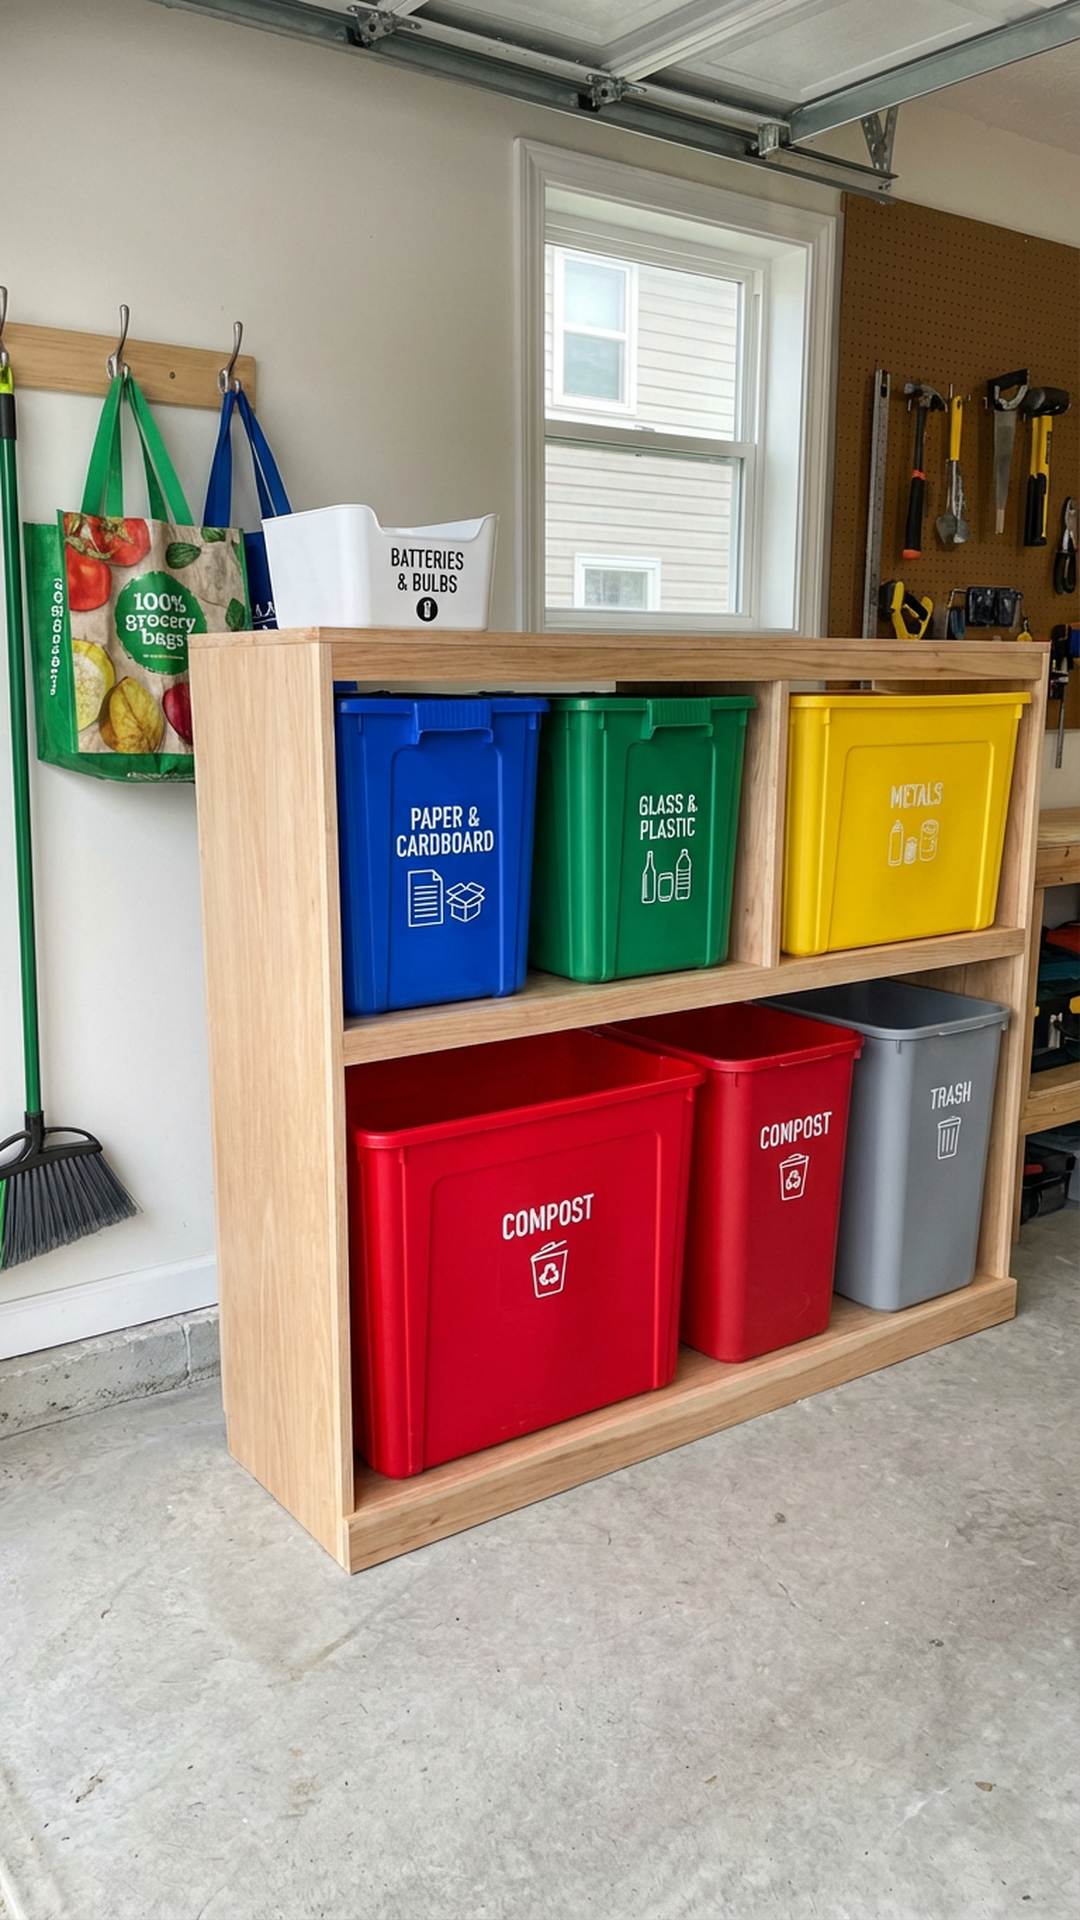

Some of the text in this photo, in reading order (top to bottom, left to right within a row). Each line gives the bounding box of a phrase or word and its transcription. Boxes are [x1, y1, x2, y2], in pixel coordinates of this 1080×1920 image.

[391, 547, 465, 571] BATTERIES
[397, 572, 458, 594] & BULBS
[133, 592, 187, 613] 100%
[125, 614, 196, 633] grocery
[639, 794, 698, 816] GLASS &
[890, 781, 944, 809] METALS
[410, 805, 480, 831] PAPER &
[640, 817, 696, 841] PLASTIC
[396, 829, 494, 858] CARDBOARD
[930, 1080, 972, 1110] TRASH
[760, 1111, 832, 1150] COMPOST
[502, 1192, 595, 1240] COMPOST
